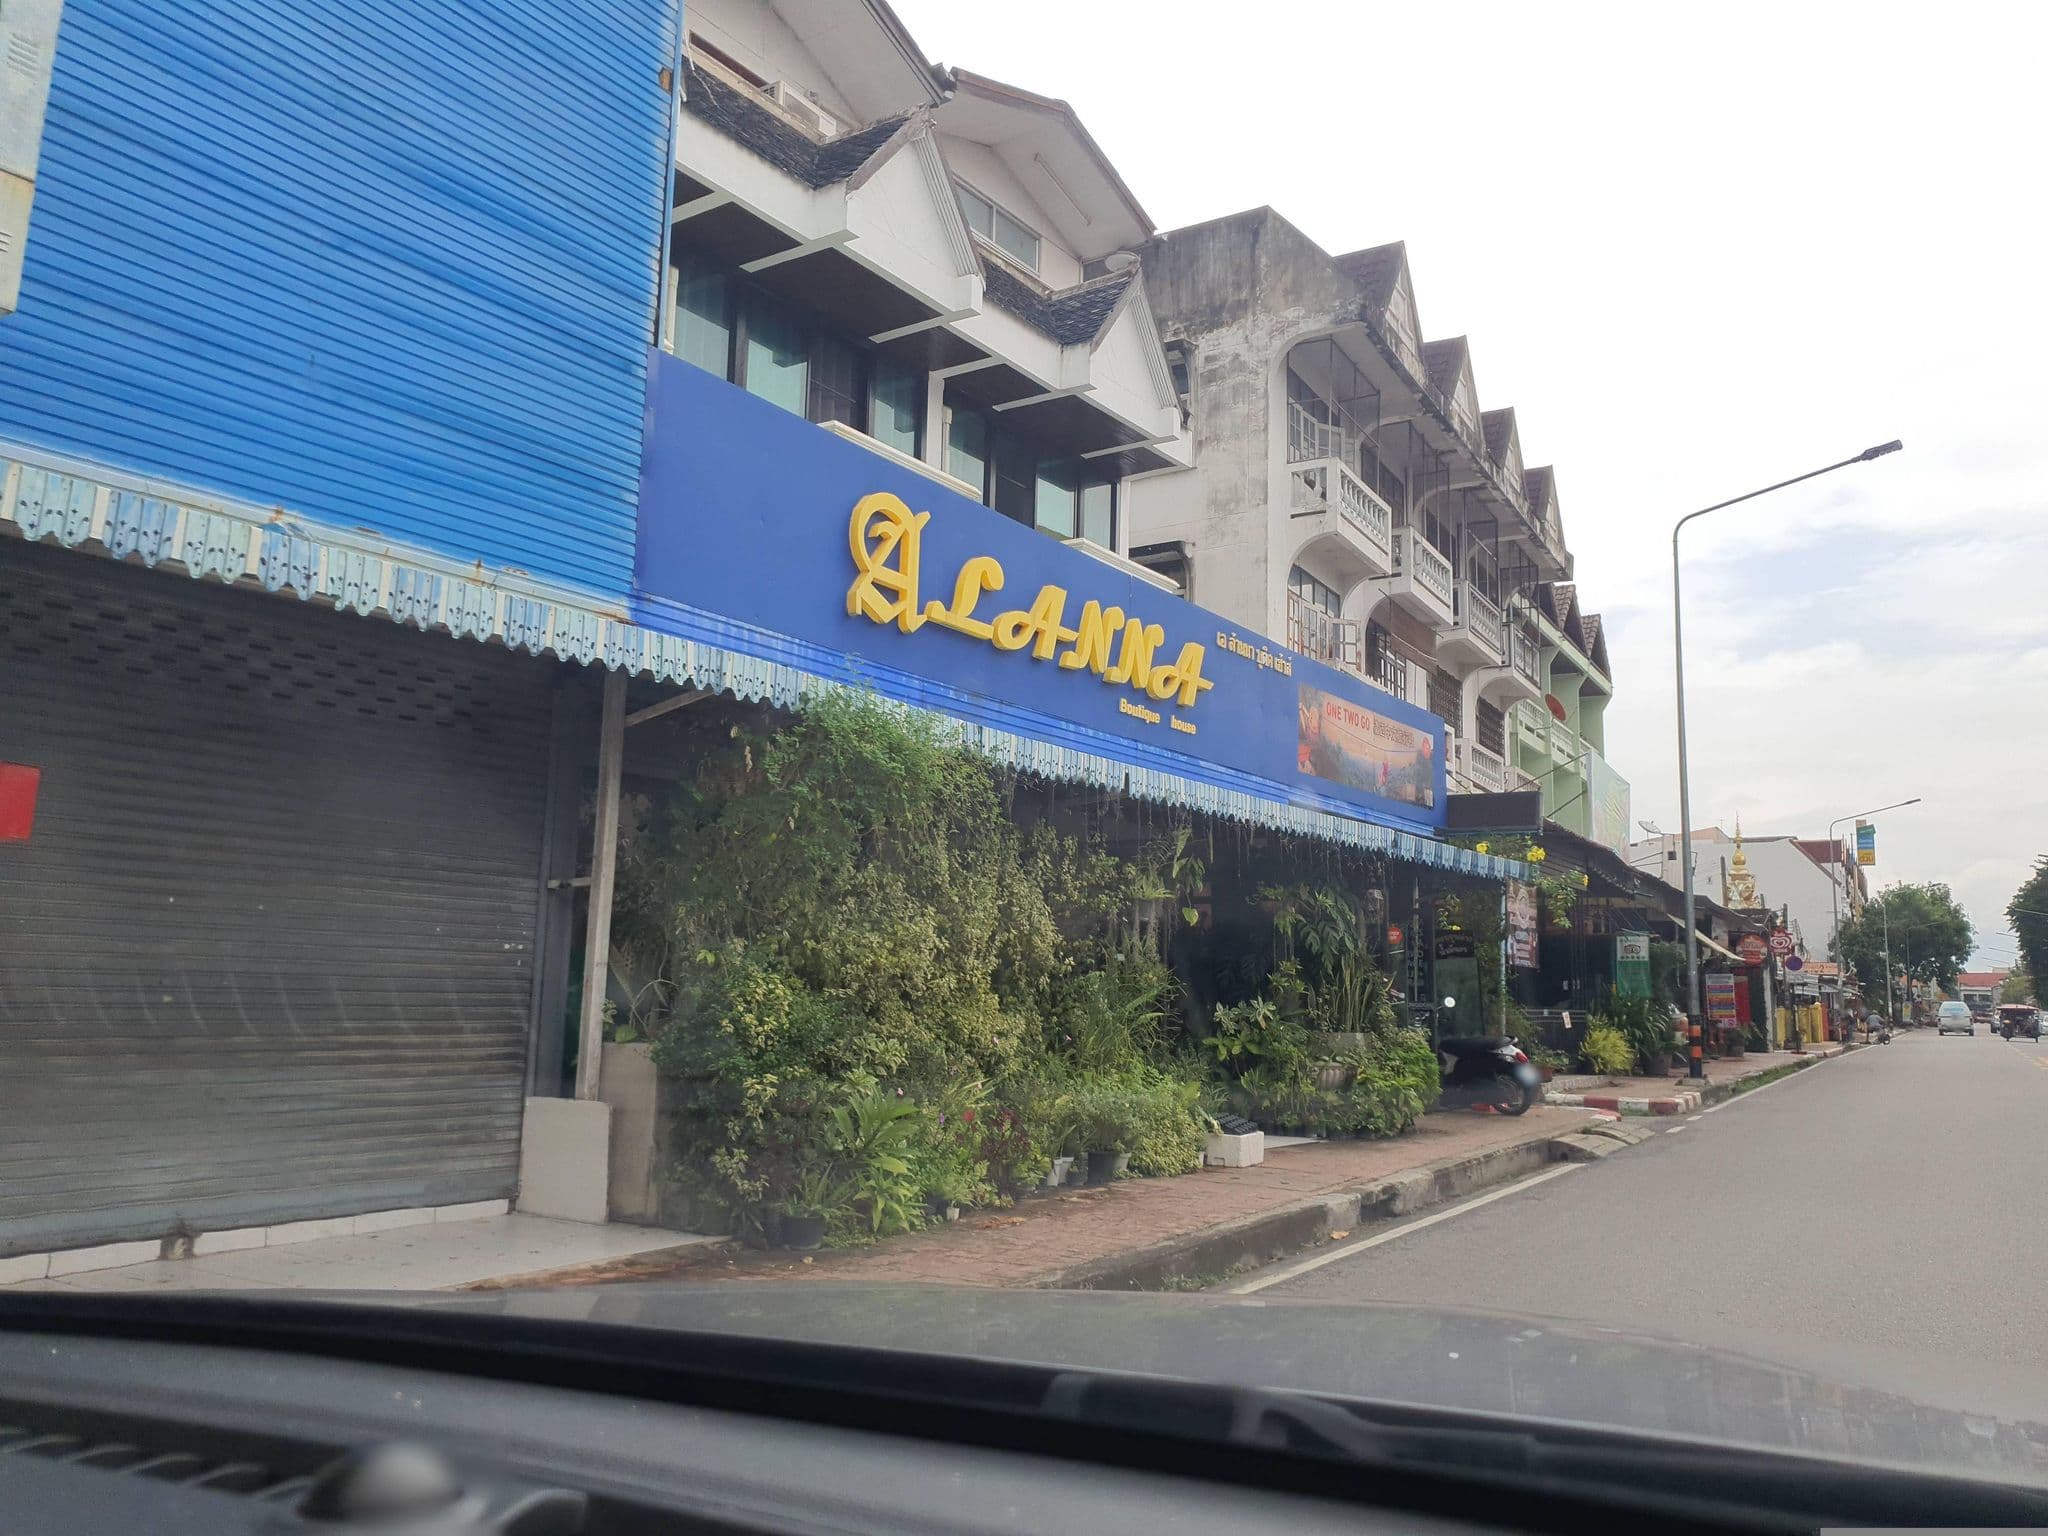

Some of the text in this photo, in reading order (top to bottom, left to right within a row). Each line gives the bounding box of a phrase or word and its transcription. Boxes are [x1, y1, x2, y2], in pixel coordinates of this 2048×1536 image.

[1119, 697, 1197, 735] Boutique house
[1326, 701, 1370, 732] ONE TWO GO
